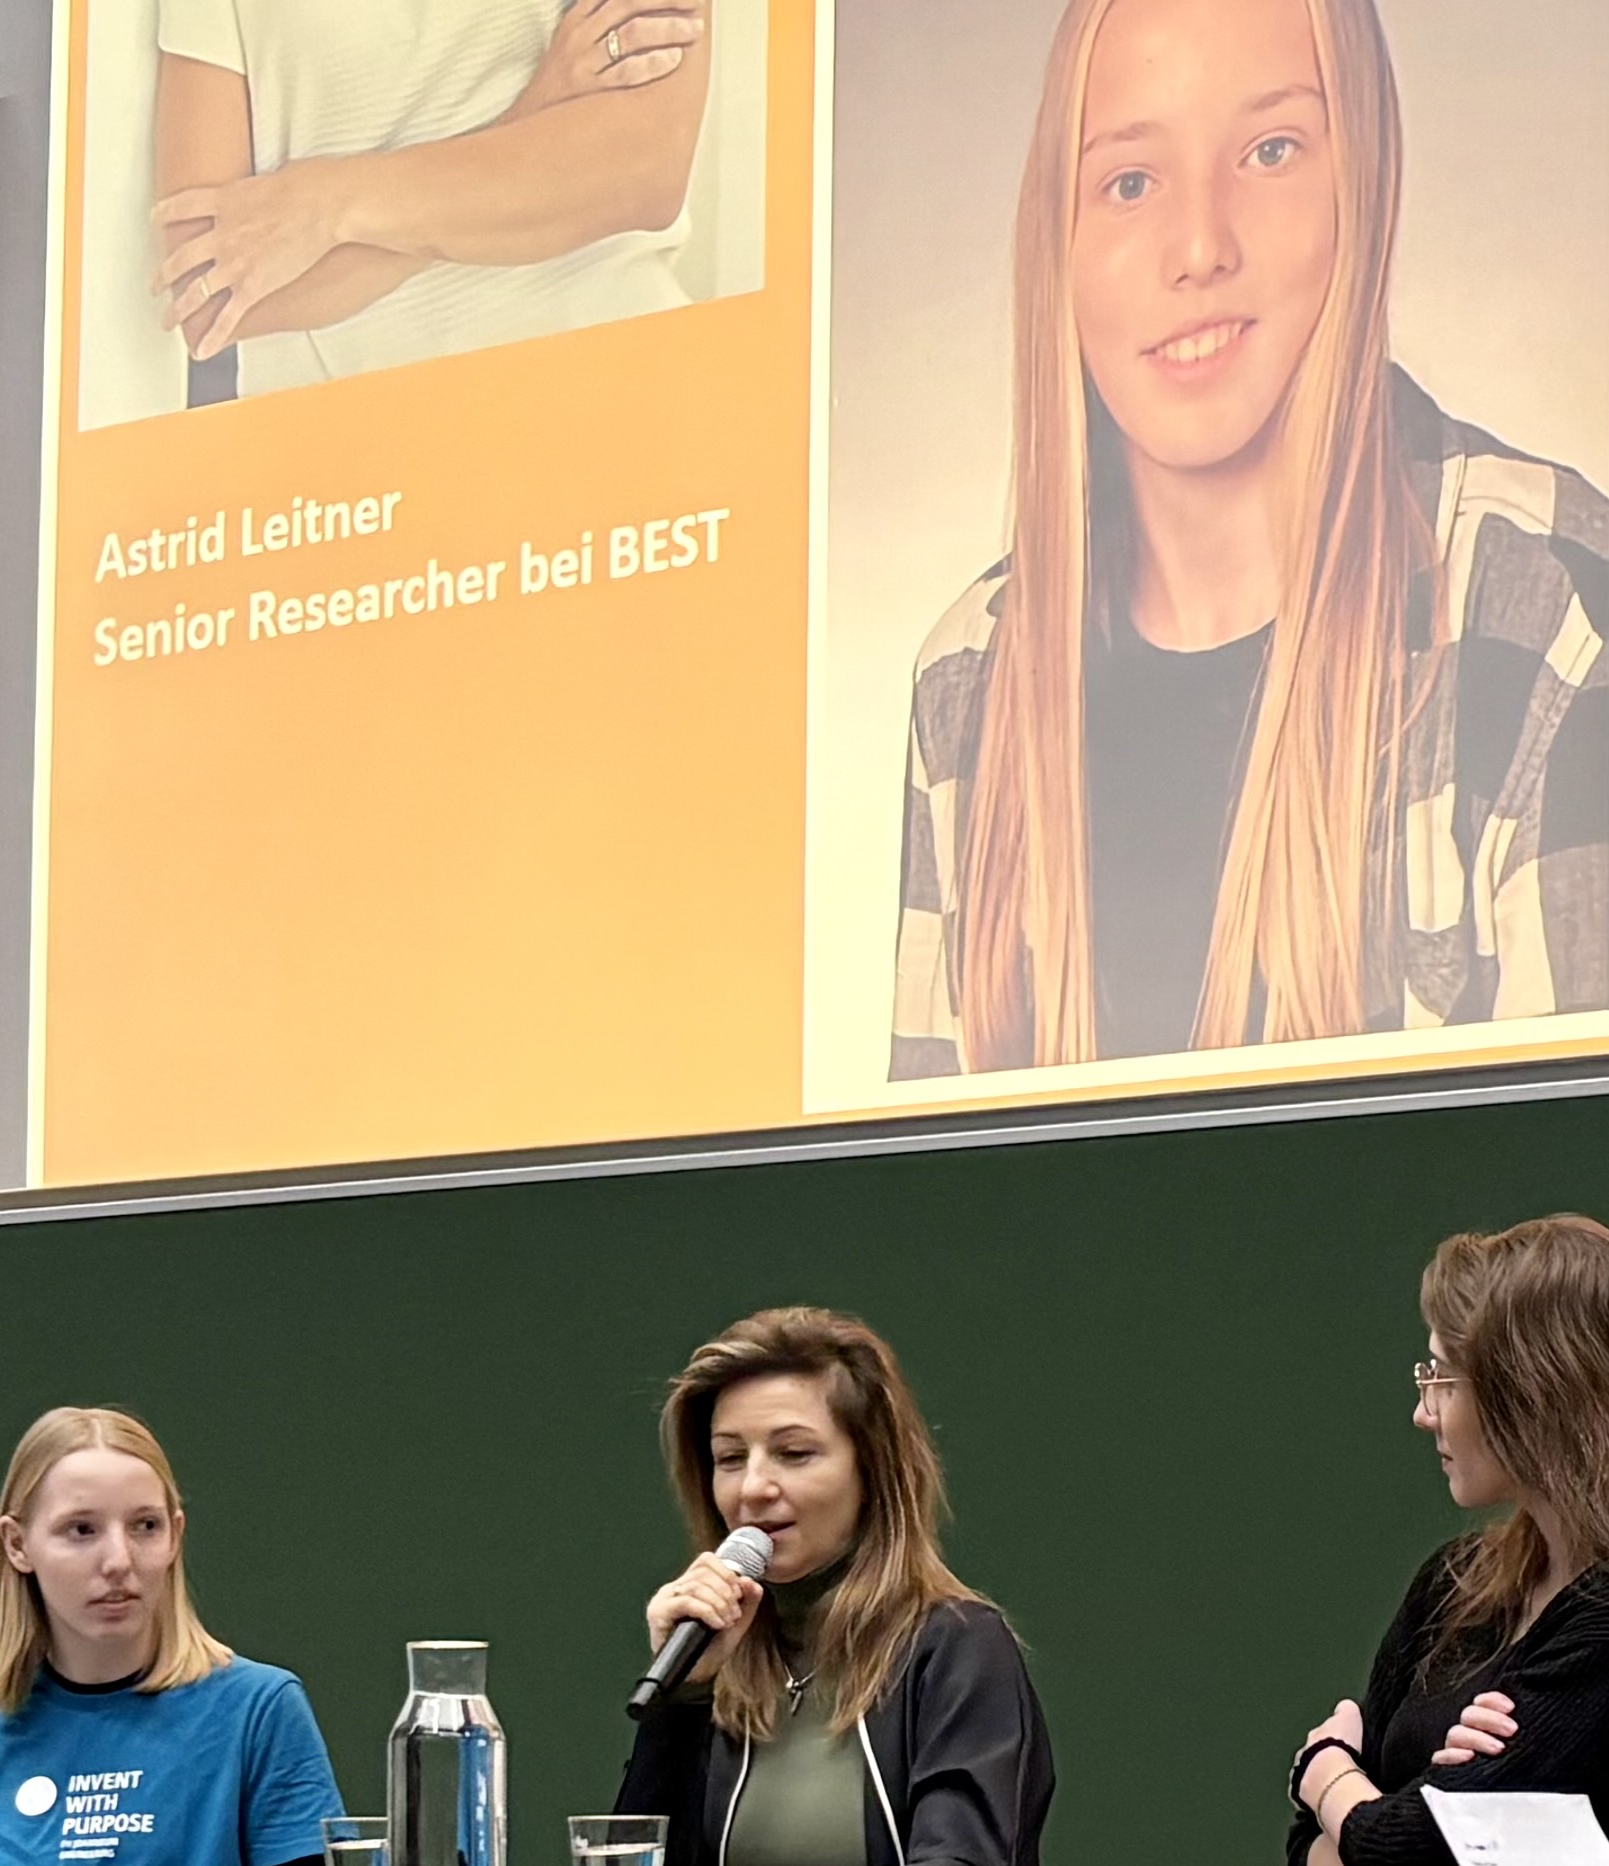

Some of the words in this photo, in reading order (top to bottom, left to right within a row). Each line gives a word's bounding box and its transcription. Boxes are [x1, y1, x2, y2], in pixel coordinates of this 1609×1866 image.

[94, 511, 225, 583] Astrid
[240, 490, 402, 557] Leitner
[93, 602, 236, 667] Senior
[248, 557, 506, 642] Researcher
[519, 530, 593, 595] bei
[608, 507, 730, 580] BEST
[68, 1770, 143, 1792] INVENT
[65, 1793, 119, 1814] WITH
[62, 1814, 154, 1835] PURPOSE
